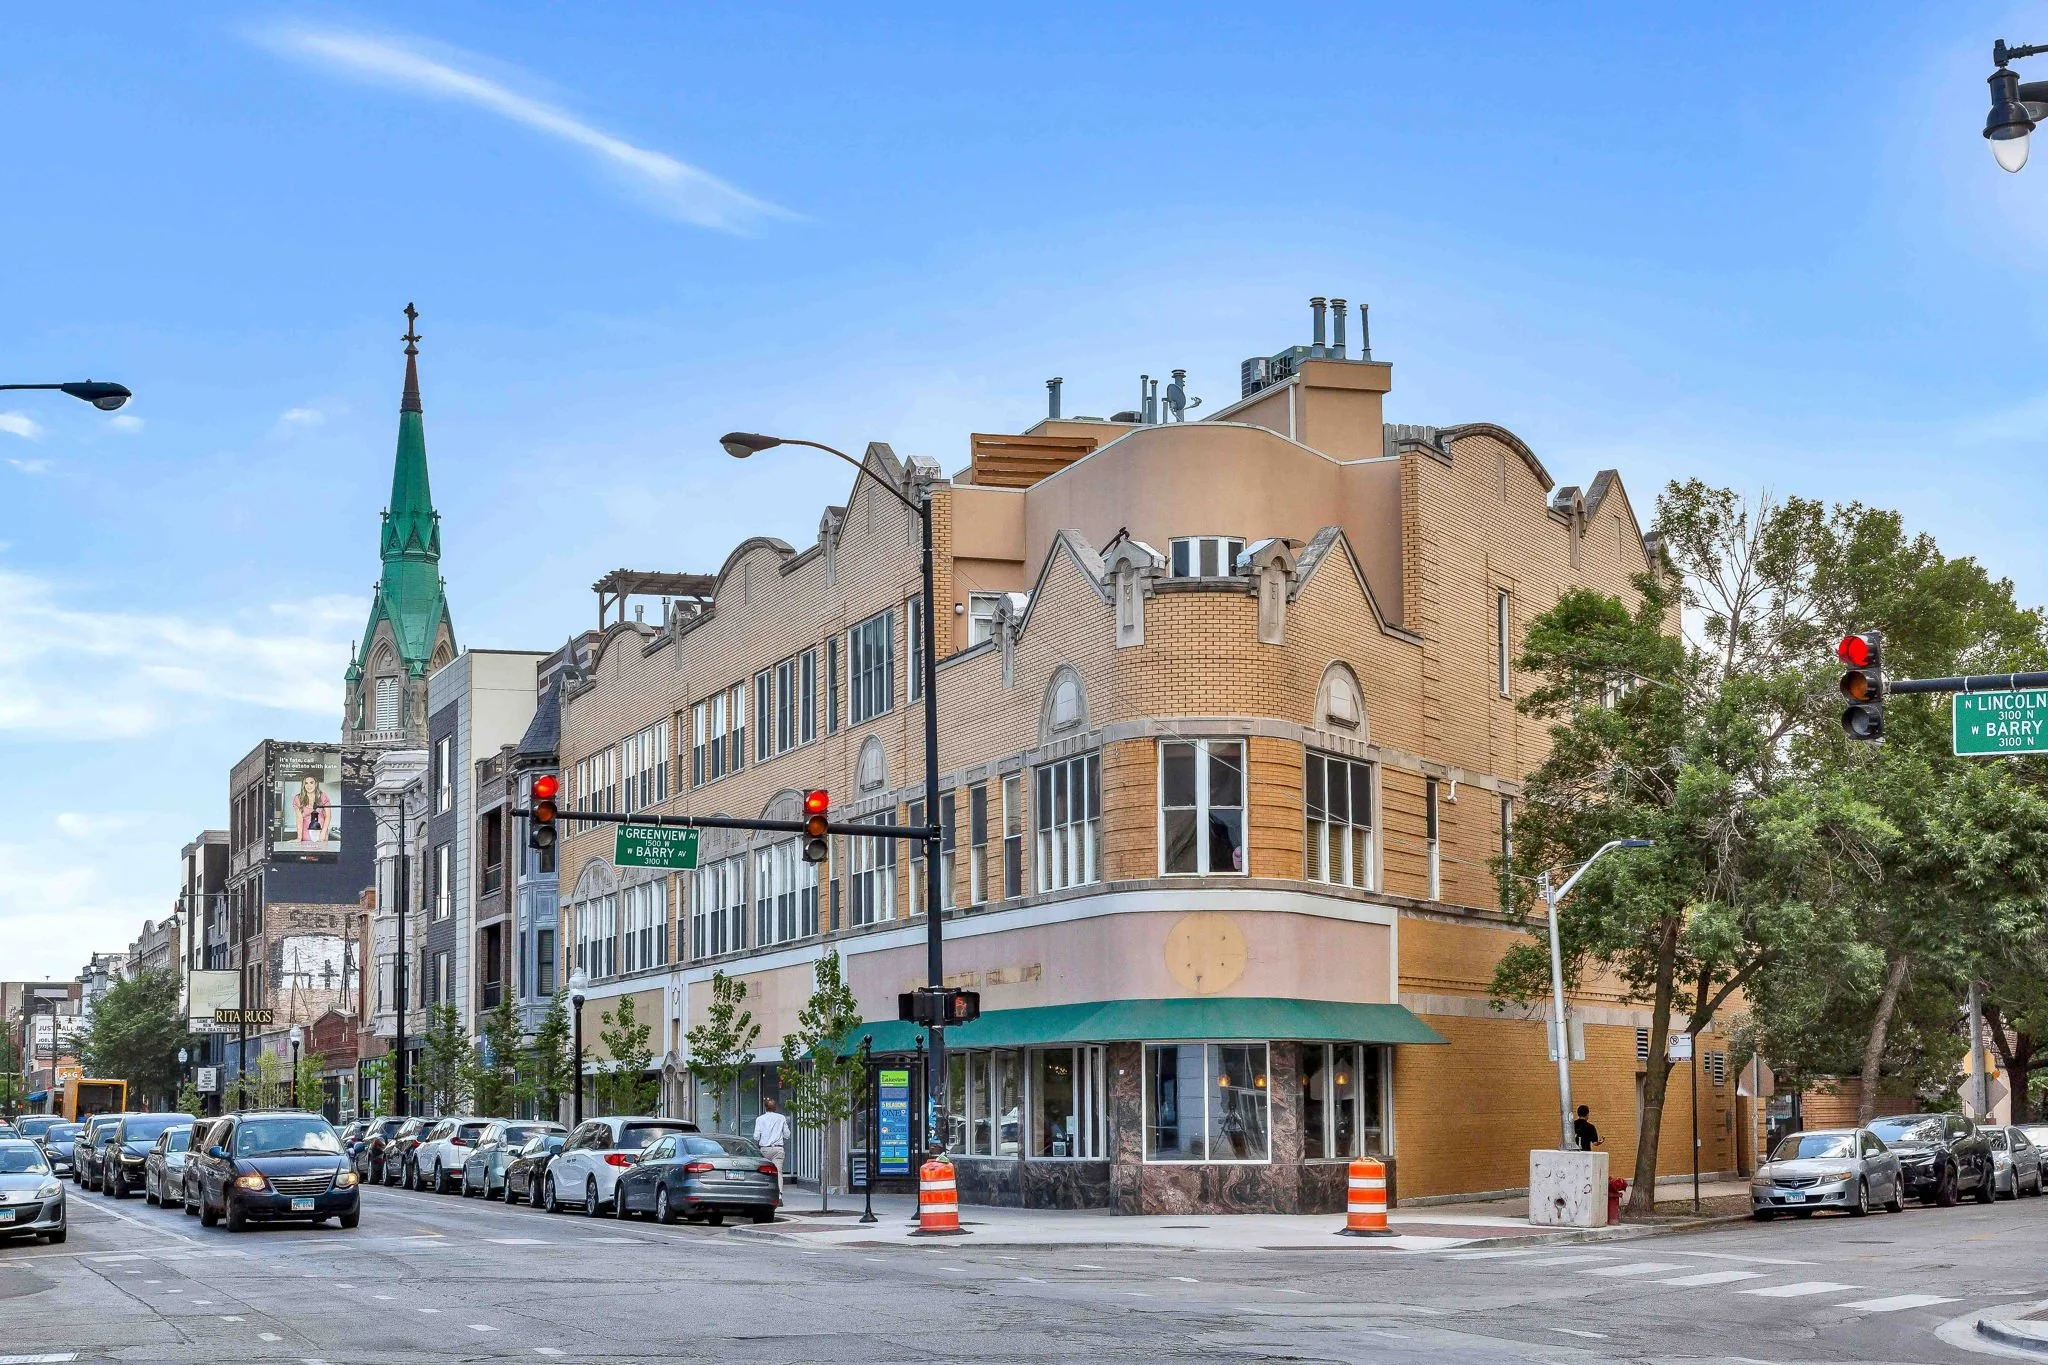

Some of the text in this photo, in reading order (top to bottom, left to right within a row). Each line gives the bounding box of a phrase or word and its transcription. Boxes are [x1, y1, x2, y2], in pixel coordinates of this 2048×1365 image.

[1965, 693, 2047, 711] N LINCOLN
[1998, 709, 2034, 720] 3100 N
[1971, 720, 2043, 737] W BARRY
[1998, 736, 2034, 747] 3100 N
[625, 828, 687, 841] GREENVIEW
[636, 846, 675, 858] BARRY
[644, 857, 661, 865] 3100
[216, 1011, 272, 1023] RITA RUGS
[882, 1109, 901, 1117] ONE
